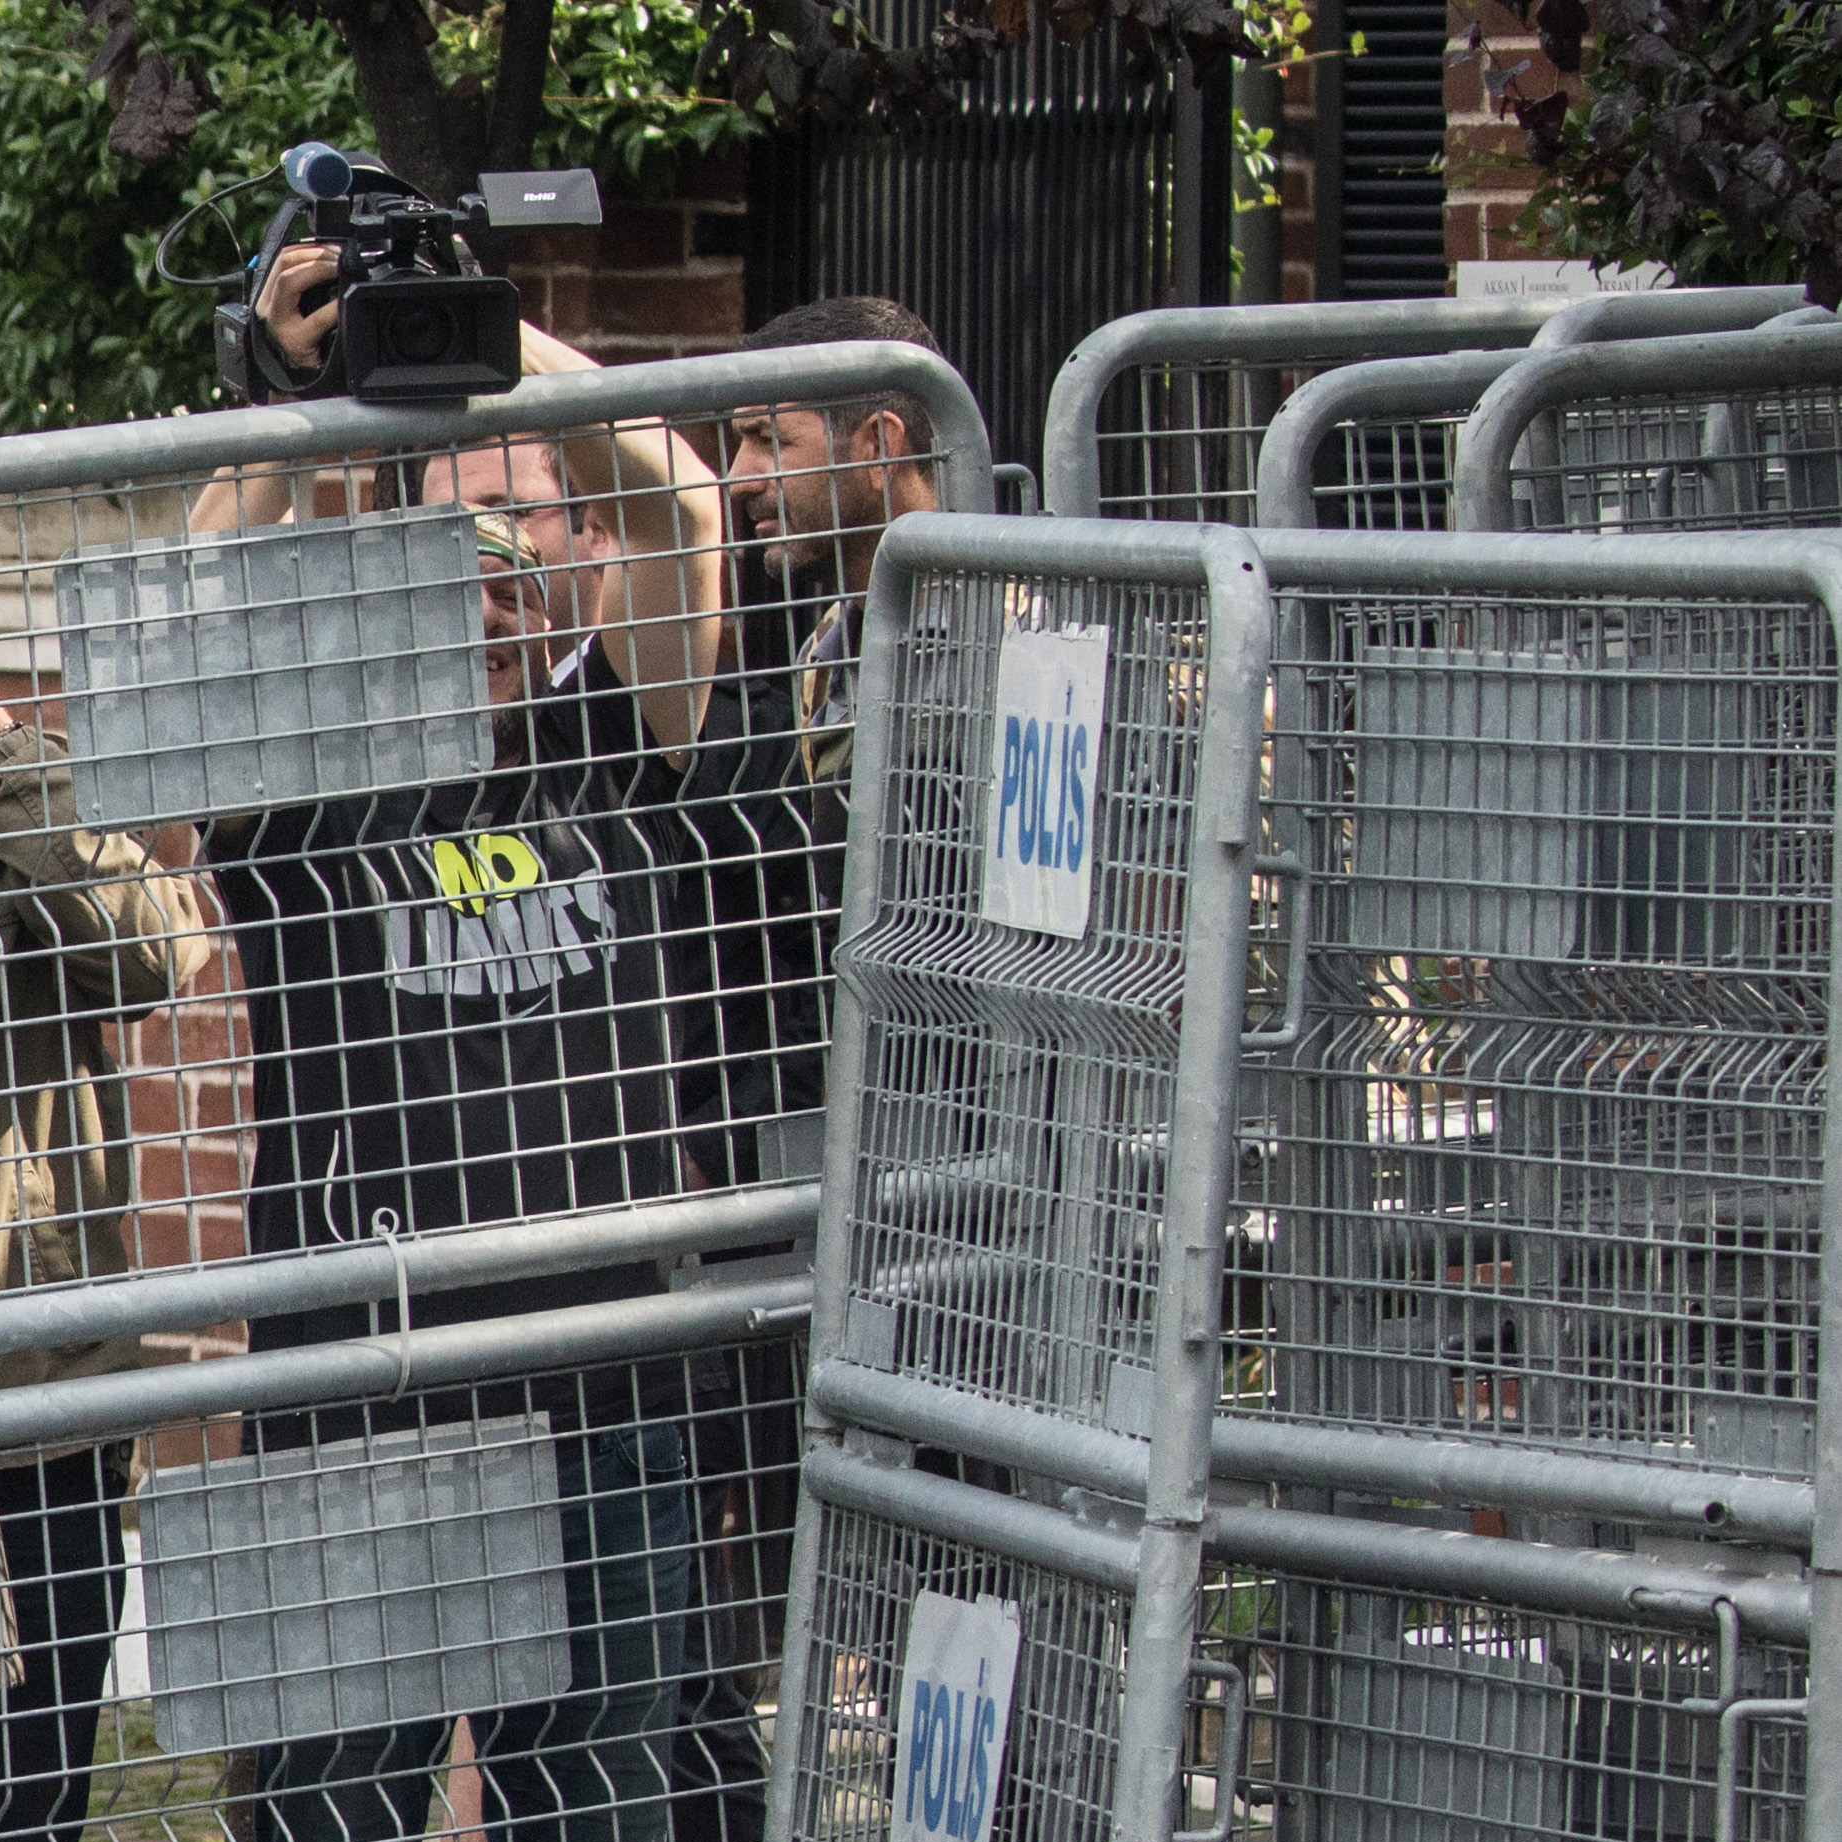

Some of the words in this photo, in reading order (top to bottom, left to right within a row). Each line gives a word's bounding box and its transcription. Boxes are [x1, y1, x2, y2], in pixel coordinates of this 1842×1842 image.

[1483, 279, 1519, 295] AKSAN
[997, 679, 1088, 874] POLİS
[433, 832, 540, 916] NO
[384, 868, 618, 996] LIMITS
